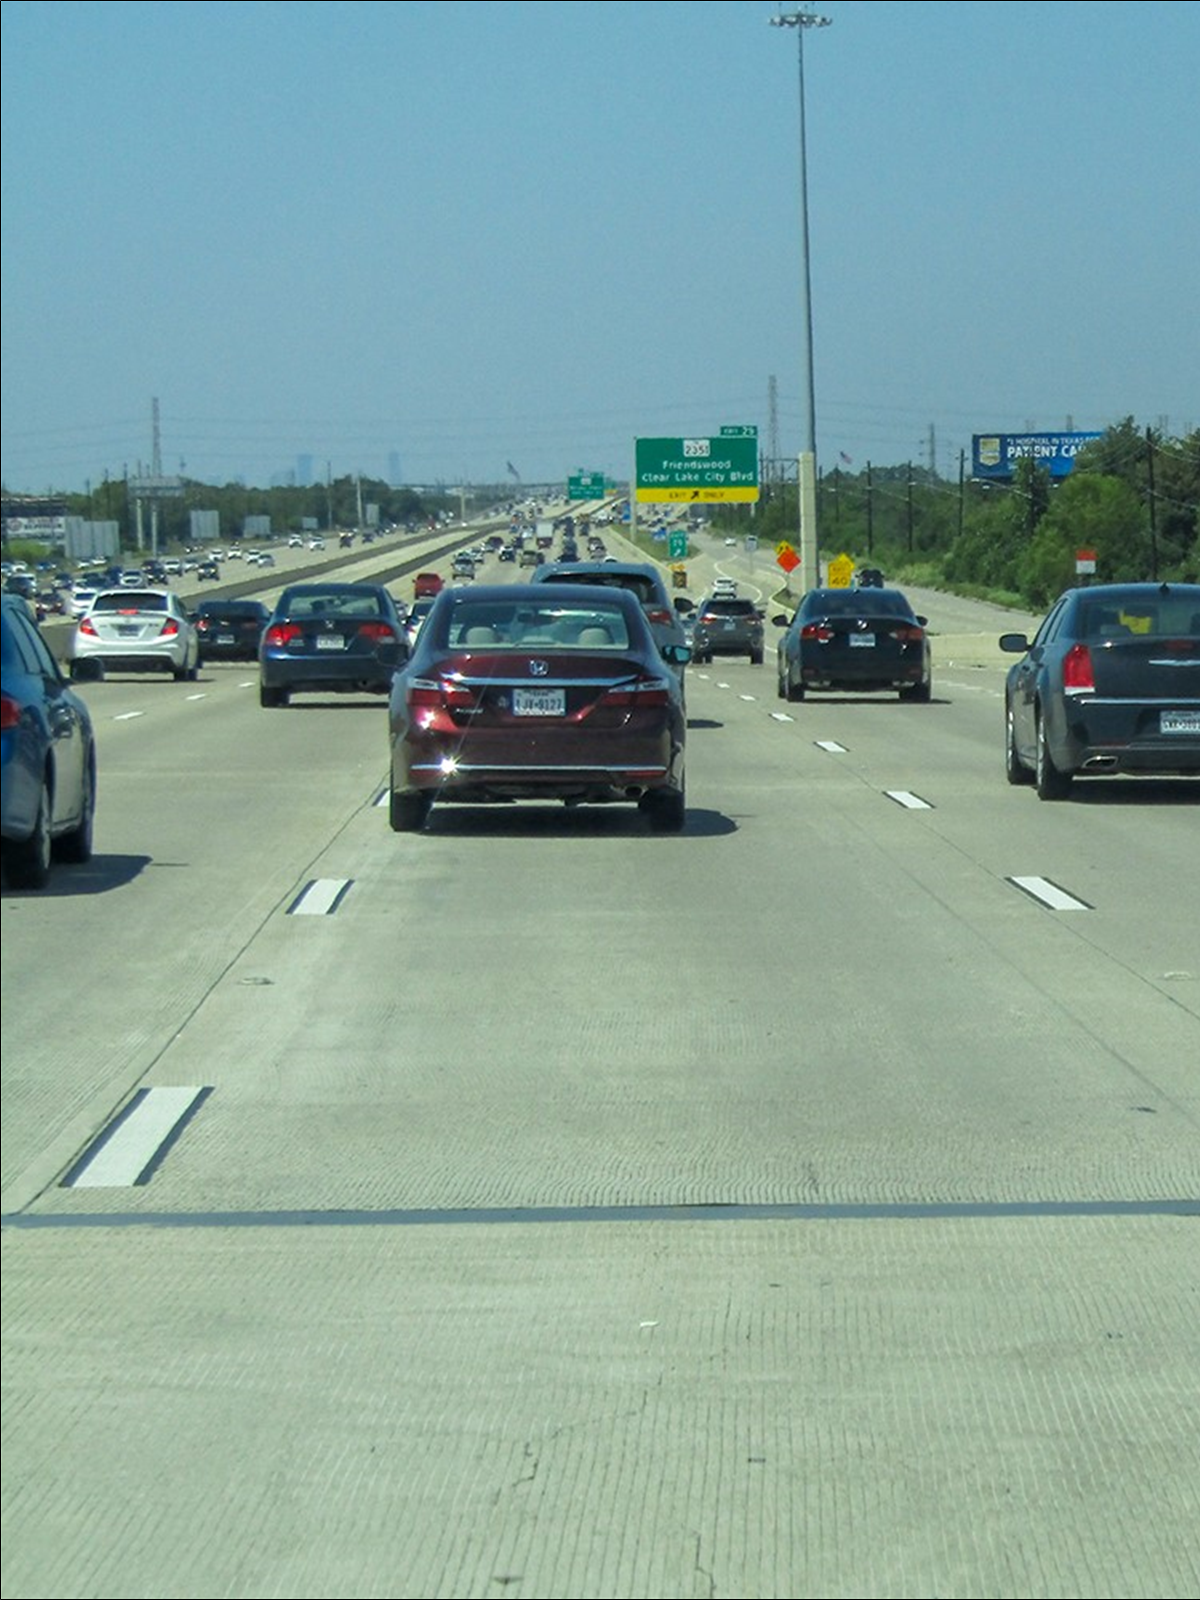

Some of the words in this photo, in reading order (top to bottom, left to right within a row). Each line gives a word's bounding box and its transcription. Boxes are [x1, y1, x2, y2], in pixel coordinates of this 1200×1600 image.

[1007, 445, 1058, 458] PATIENT
[662, 460, 732, 470] Friendswood
[641, 472, 670, 482] Clear
[675, 472, 700, 482] Lake
[704, 471, 725, 483] City
[730, 470, 754, 481] Blvd
